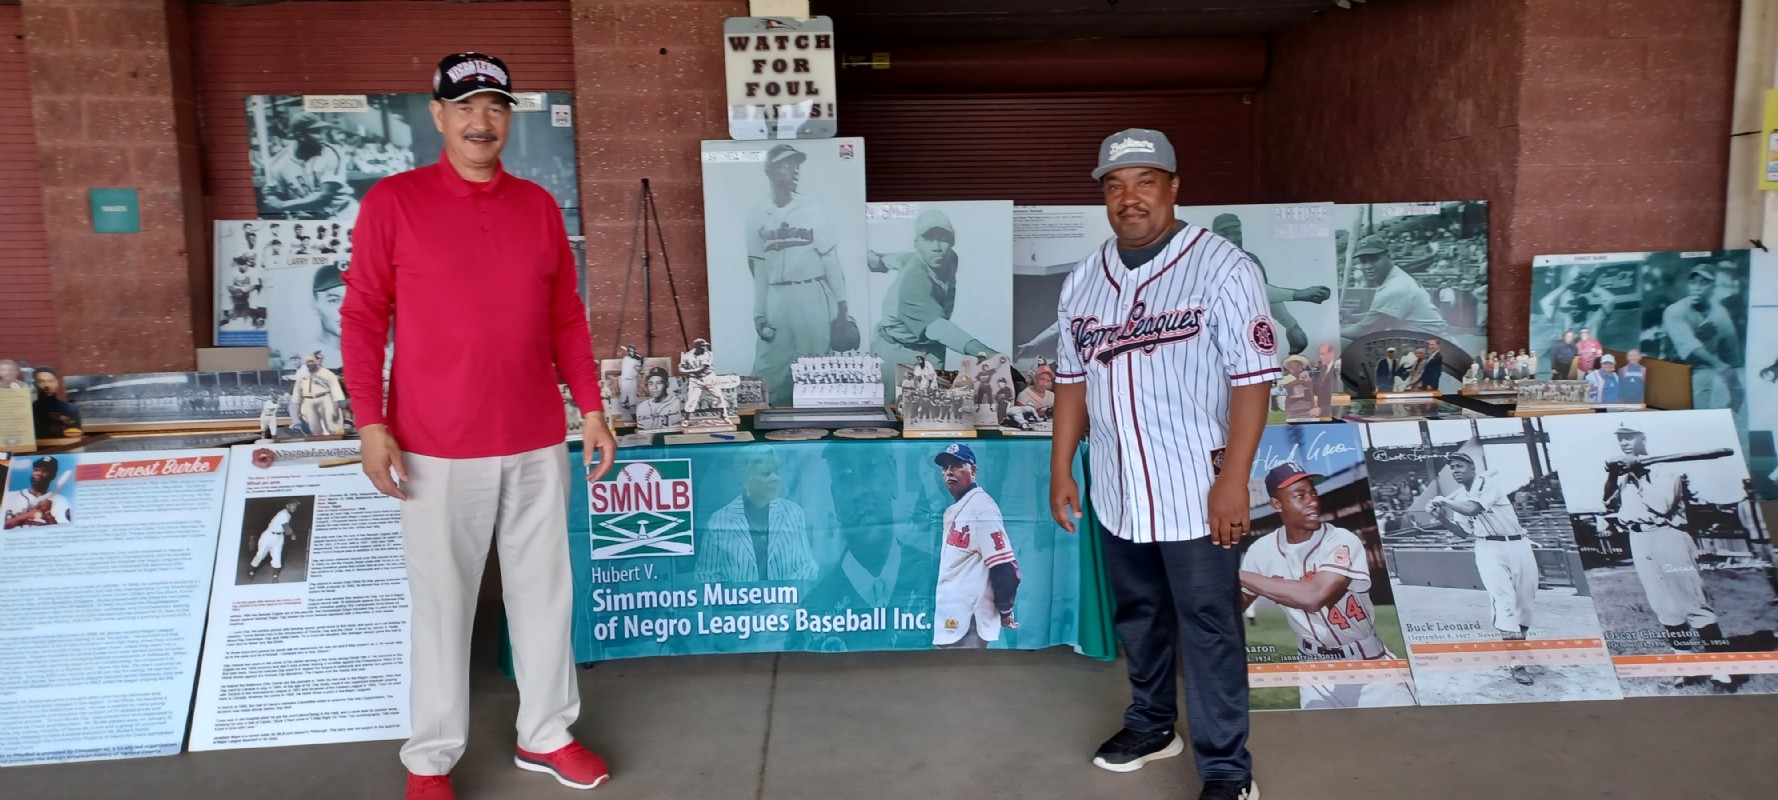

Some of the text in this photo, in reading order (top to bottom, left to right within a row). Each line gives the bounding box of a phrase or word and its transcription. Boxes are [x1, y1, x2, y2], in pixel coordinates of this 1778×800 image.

[728, 35, 831, 51] WATCH
[752, 58, 811, 74] FOR
[745, 81, 819, 97] FOUL
[305, 98, 364, 109] JOSH GIBSON
[1109, 137, 1155, 157] Baltimore
[1071, 316, 1122, 366] Negro
[1118, 300, 1203, 356] Leagues
[276, 447, 357, 459] NEGRO LEAGUES
[105, 457, 210, 479] Ernest Burke
[592, 481, 690, 513] SMNLB
[591, 563, 657, 583] Hubert V.
[593, 583, 798, 612] Simmons Museum
[1327, 594, 1367, 630] 44
[594, 616, 618, 641] of
[624, 614, 691, 643] Negro
[698, 611, 790, 639] Leagues
[796, 607, 886, 632] Baseball
[893, 607, 931, 630] Inc.
[1406, 621, 1481, 632] Buck Leonard
[1408, 633, 1445, 641] (September
[1605, 629, 1701, 640] Oscar Charleston
[1281, 654, 1308, 662] January
